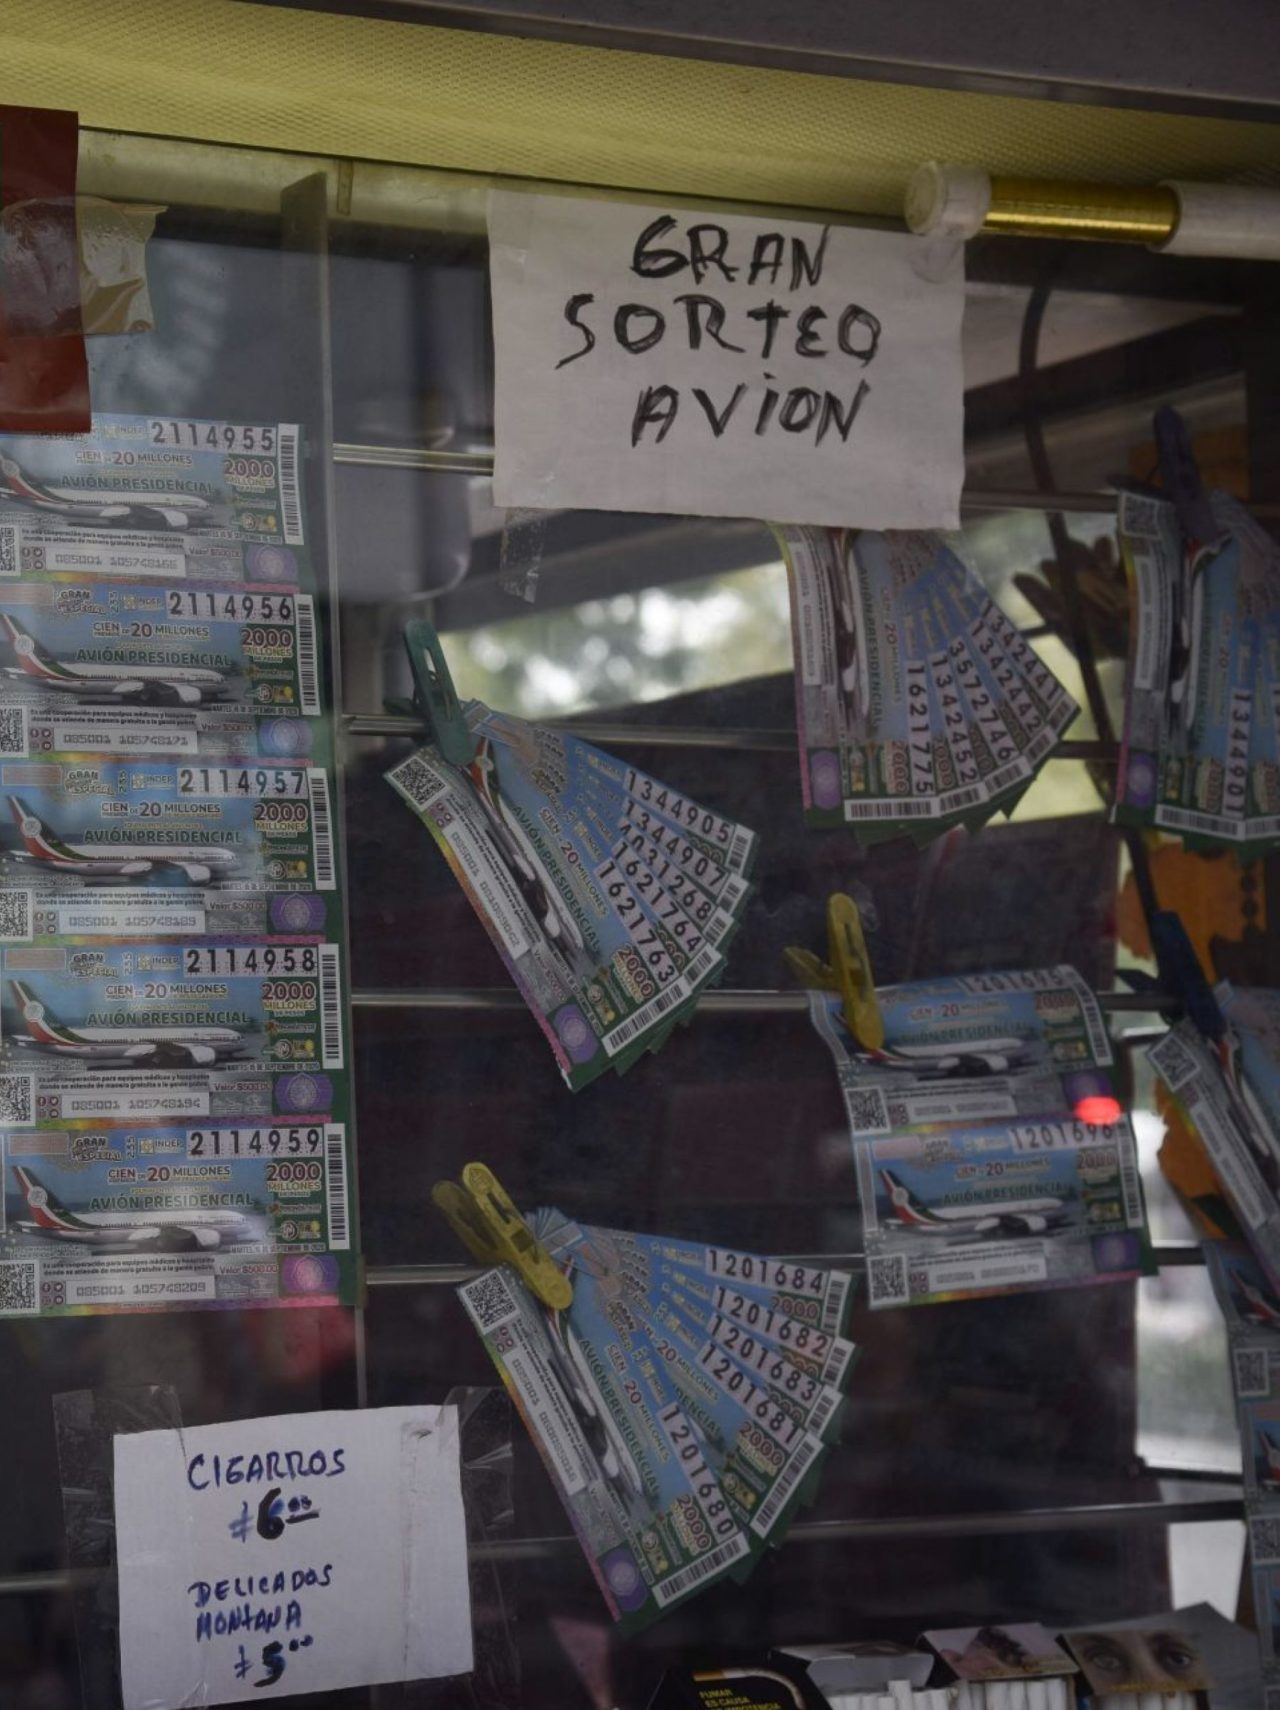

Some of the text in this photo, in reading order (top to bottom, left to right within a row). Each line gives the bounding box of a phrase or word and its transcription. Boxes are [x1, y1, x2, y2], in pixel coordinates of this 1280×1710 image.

[630, 215, 830, 290] GRAN
[556, 293, 882, 368] SORTEO
[153, 423, 273, 453] 2114955
[171, 594, 293, 620] 2114956
[128, 648, 232, 666] PRESIDENCIAL
[243, 629, 295, 647] 2000
[908, 664, 934, 793] 1621775
[181, 771, 306, 794] 2114957
[254, 805, 308, 822] 2000
[628, 770, 730, 843] 1344905
[137, 828, 243, 843] PRESIDENCIAL
[626, 800, 726, 886] 1344907
[614, 843, 702, 952] 1621764
[599, 862, 674, 985] 1621763
[187, 950, 315, 973] 2114958
[261, 983, 317, 1000] 2000
[141, 1010, 250, 1024] PRESIDENCIAL
[191, 1129, 321, 1155] 2114959
[266, 1164, 322, 1182] 2000
[144, 1191, 254, 1208] PRESIDENCIAL
[709, 1250, 823, 1295] 1201684
[716, 1286, 829, 1355] 1201682
[710, 1314, 818, 1402] 1201683
[701, 1343, 801, 1445] 1201681
[187, 1449, 346, 1490] CIGARROS
[662, 1405, 735, 1536] 1201680
[188, 1564, 333, 1607] DELICADOS
